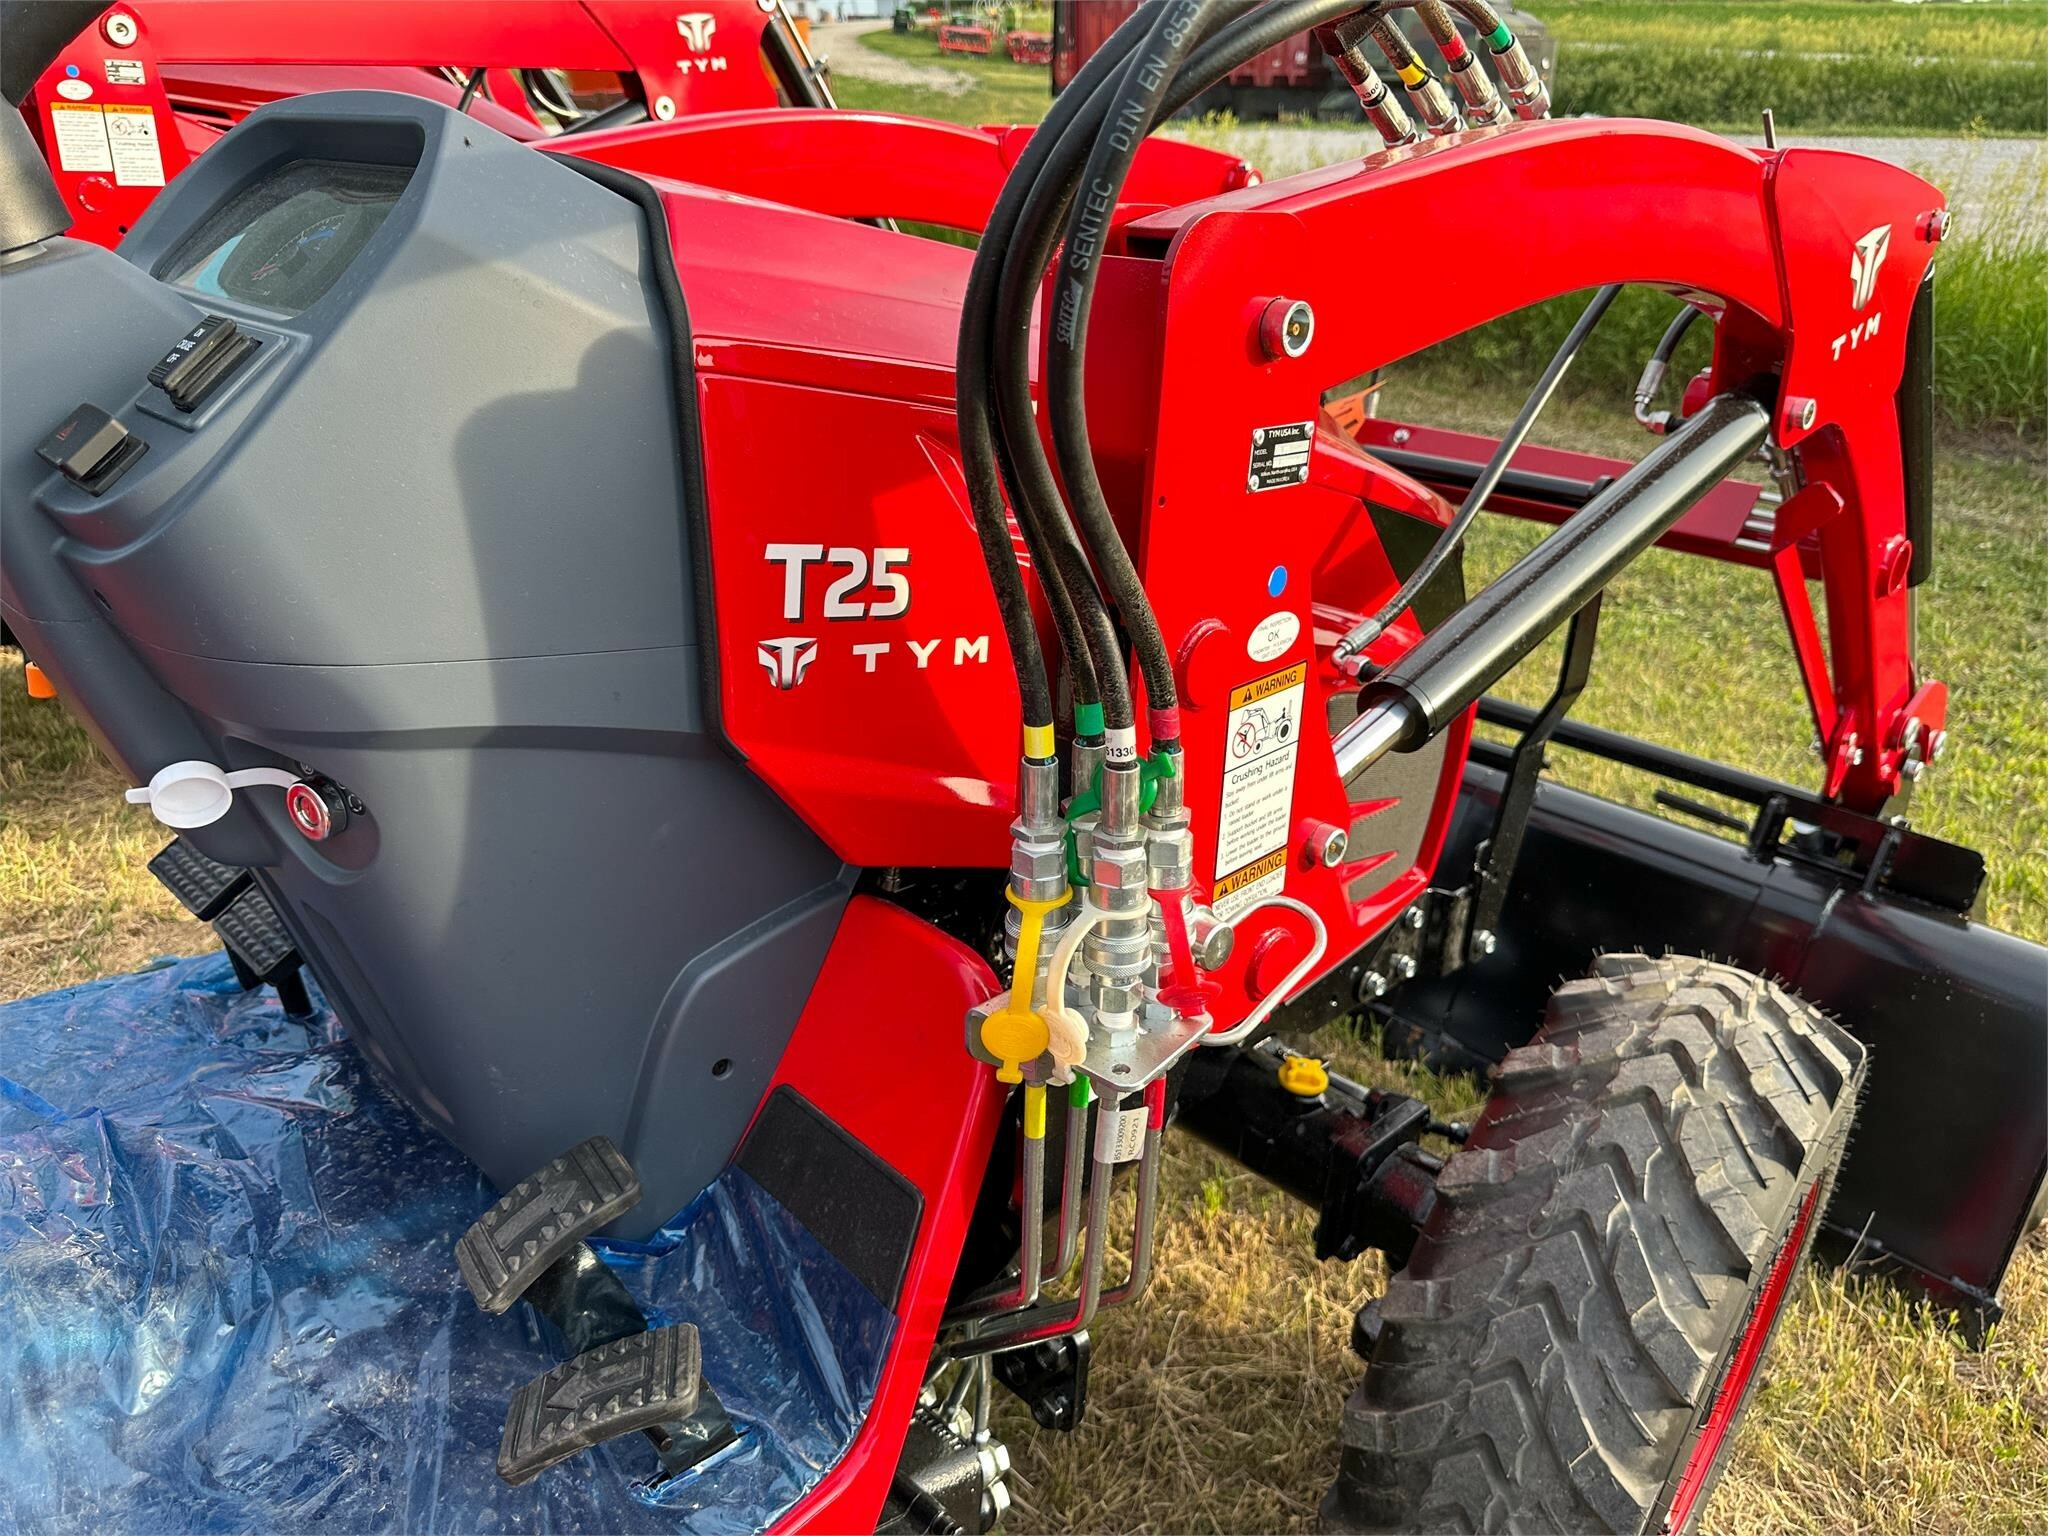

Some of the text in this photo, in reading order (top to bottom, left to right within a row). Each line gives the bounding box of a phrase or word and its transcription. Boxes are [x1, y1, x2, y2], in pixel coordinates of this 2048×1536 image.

[676, 56, 728, 75] TYM
[1056, 285, 1078, 346] SENTEC
[1070, 178, 1113, 271] SENTEC
[1108, 100, 1146, 152] DIN
[1137, 54, 1168, 92] EN
[1831, 312, 1881, 361] TYM
[765, 543, 914, 623] T25
[853, 635, 990, 673] TYM
[1268, 629, 1280, 642] OK
[1256, 670, 1297, 696] WARNING
[1231, 750, 1290, 785] Crushing Hazard
[1231, 853, 1282, 890] WARNING
[1128, 1117, 1140, 1156] RC0921
